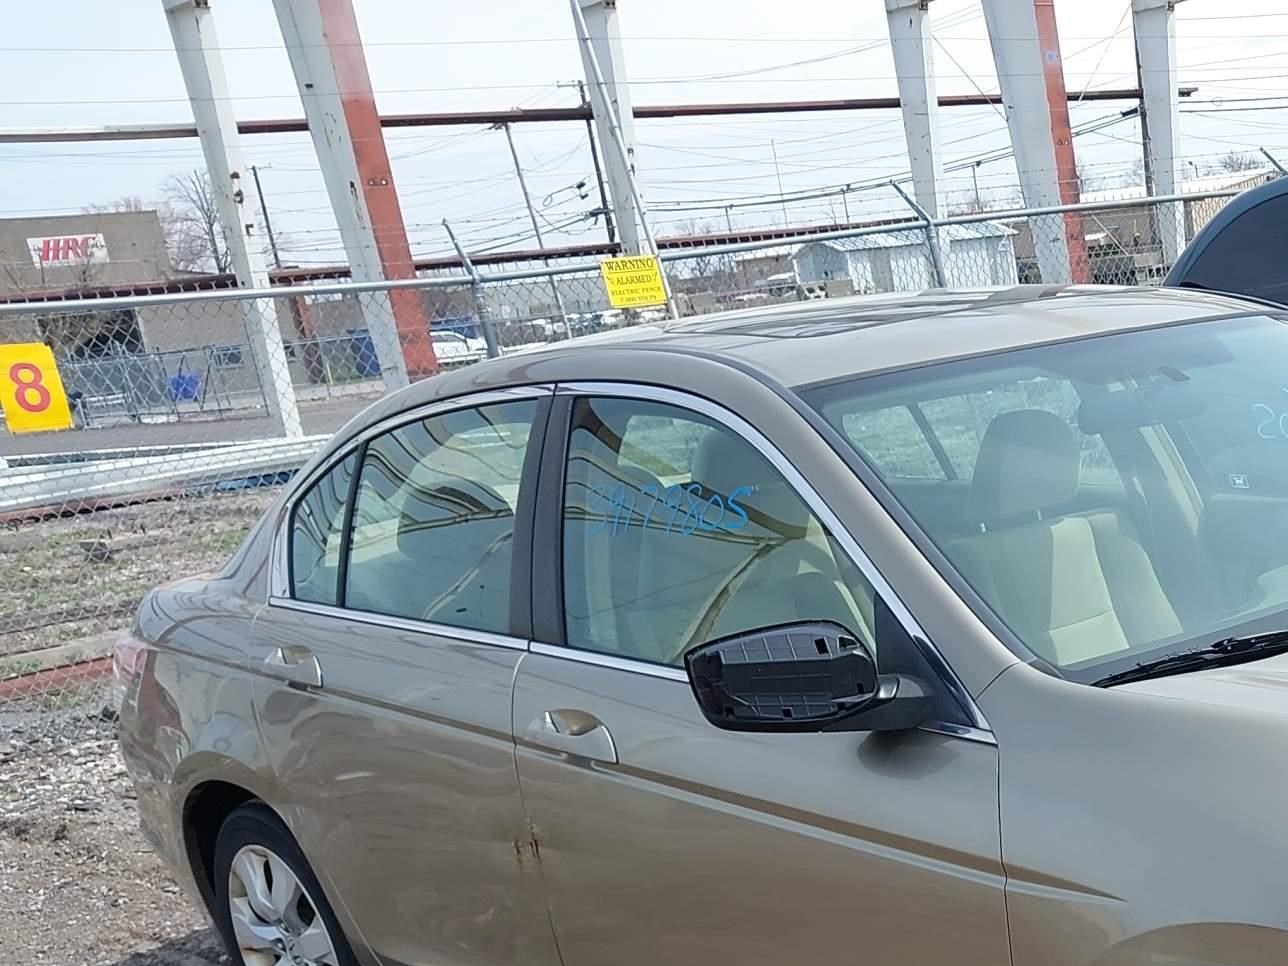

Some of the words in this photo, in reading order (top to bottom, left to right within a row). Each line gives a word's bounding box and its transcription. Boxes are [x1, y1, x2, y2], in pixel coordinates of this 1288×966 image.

[40, 236, 97, 261] HRC
[605, 258, 654, 271] WARNING
[616, 275, 652, 286] ALARMED
[9, 362, 51, 413] 8
